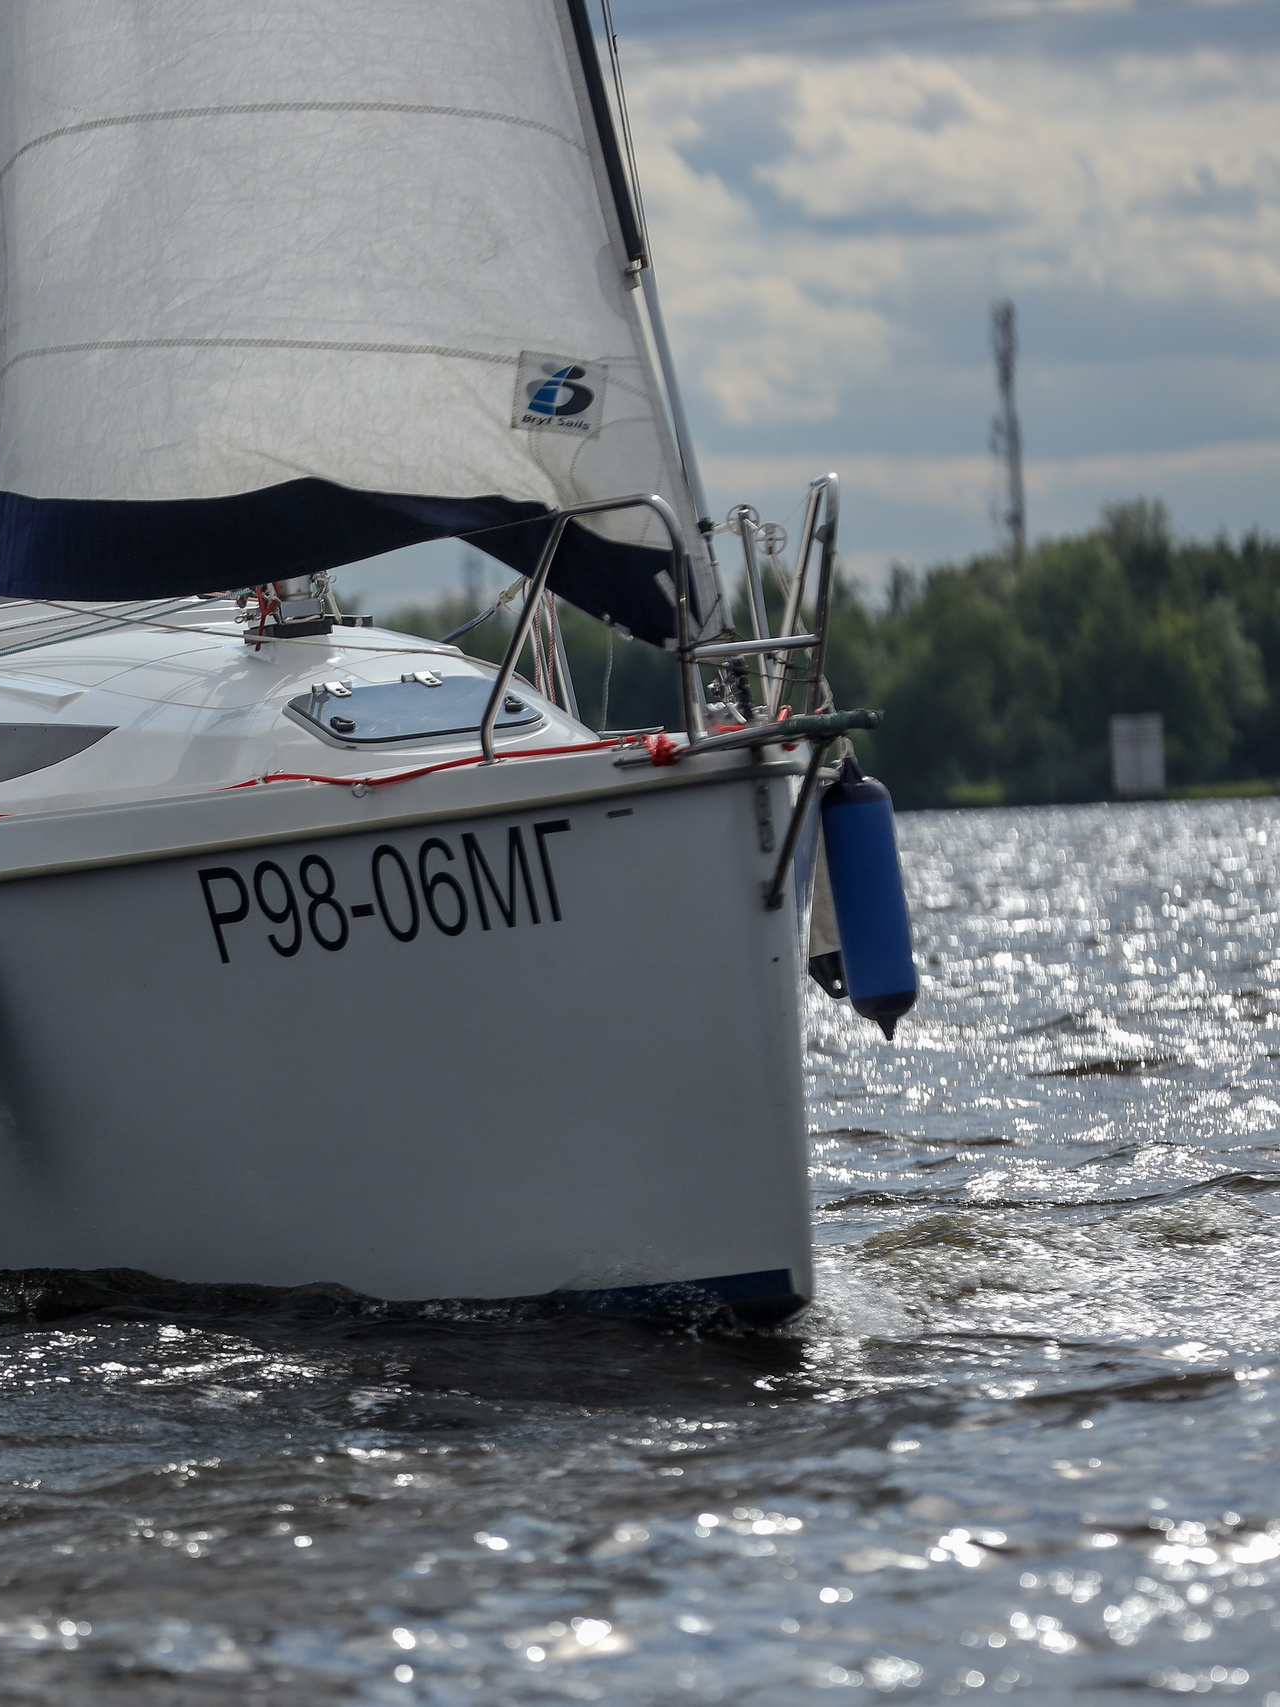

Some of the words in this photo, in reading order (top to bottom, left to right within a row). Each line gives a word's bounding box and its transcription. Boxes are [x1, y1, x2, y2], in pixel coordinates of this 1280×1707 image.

[521, 413, 553, 426] Bryt
[557, 416, 591, 430] Sails
[197, 818, 572, 964] Р98-06МГ
